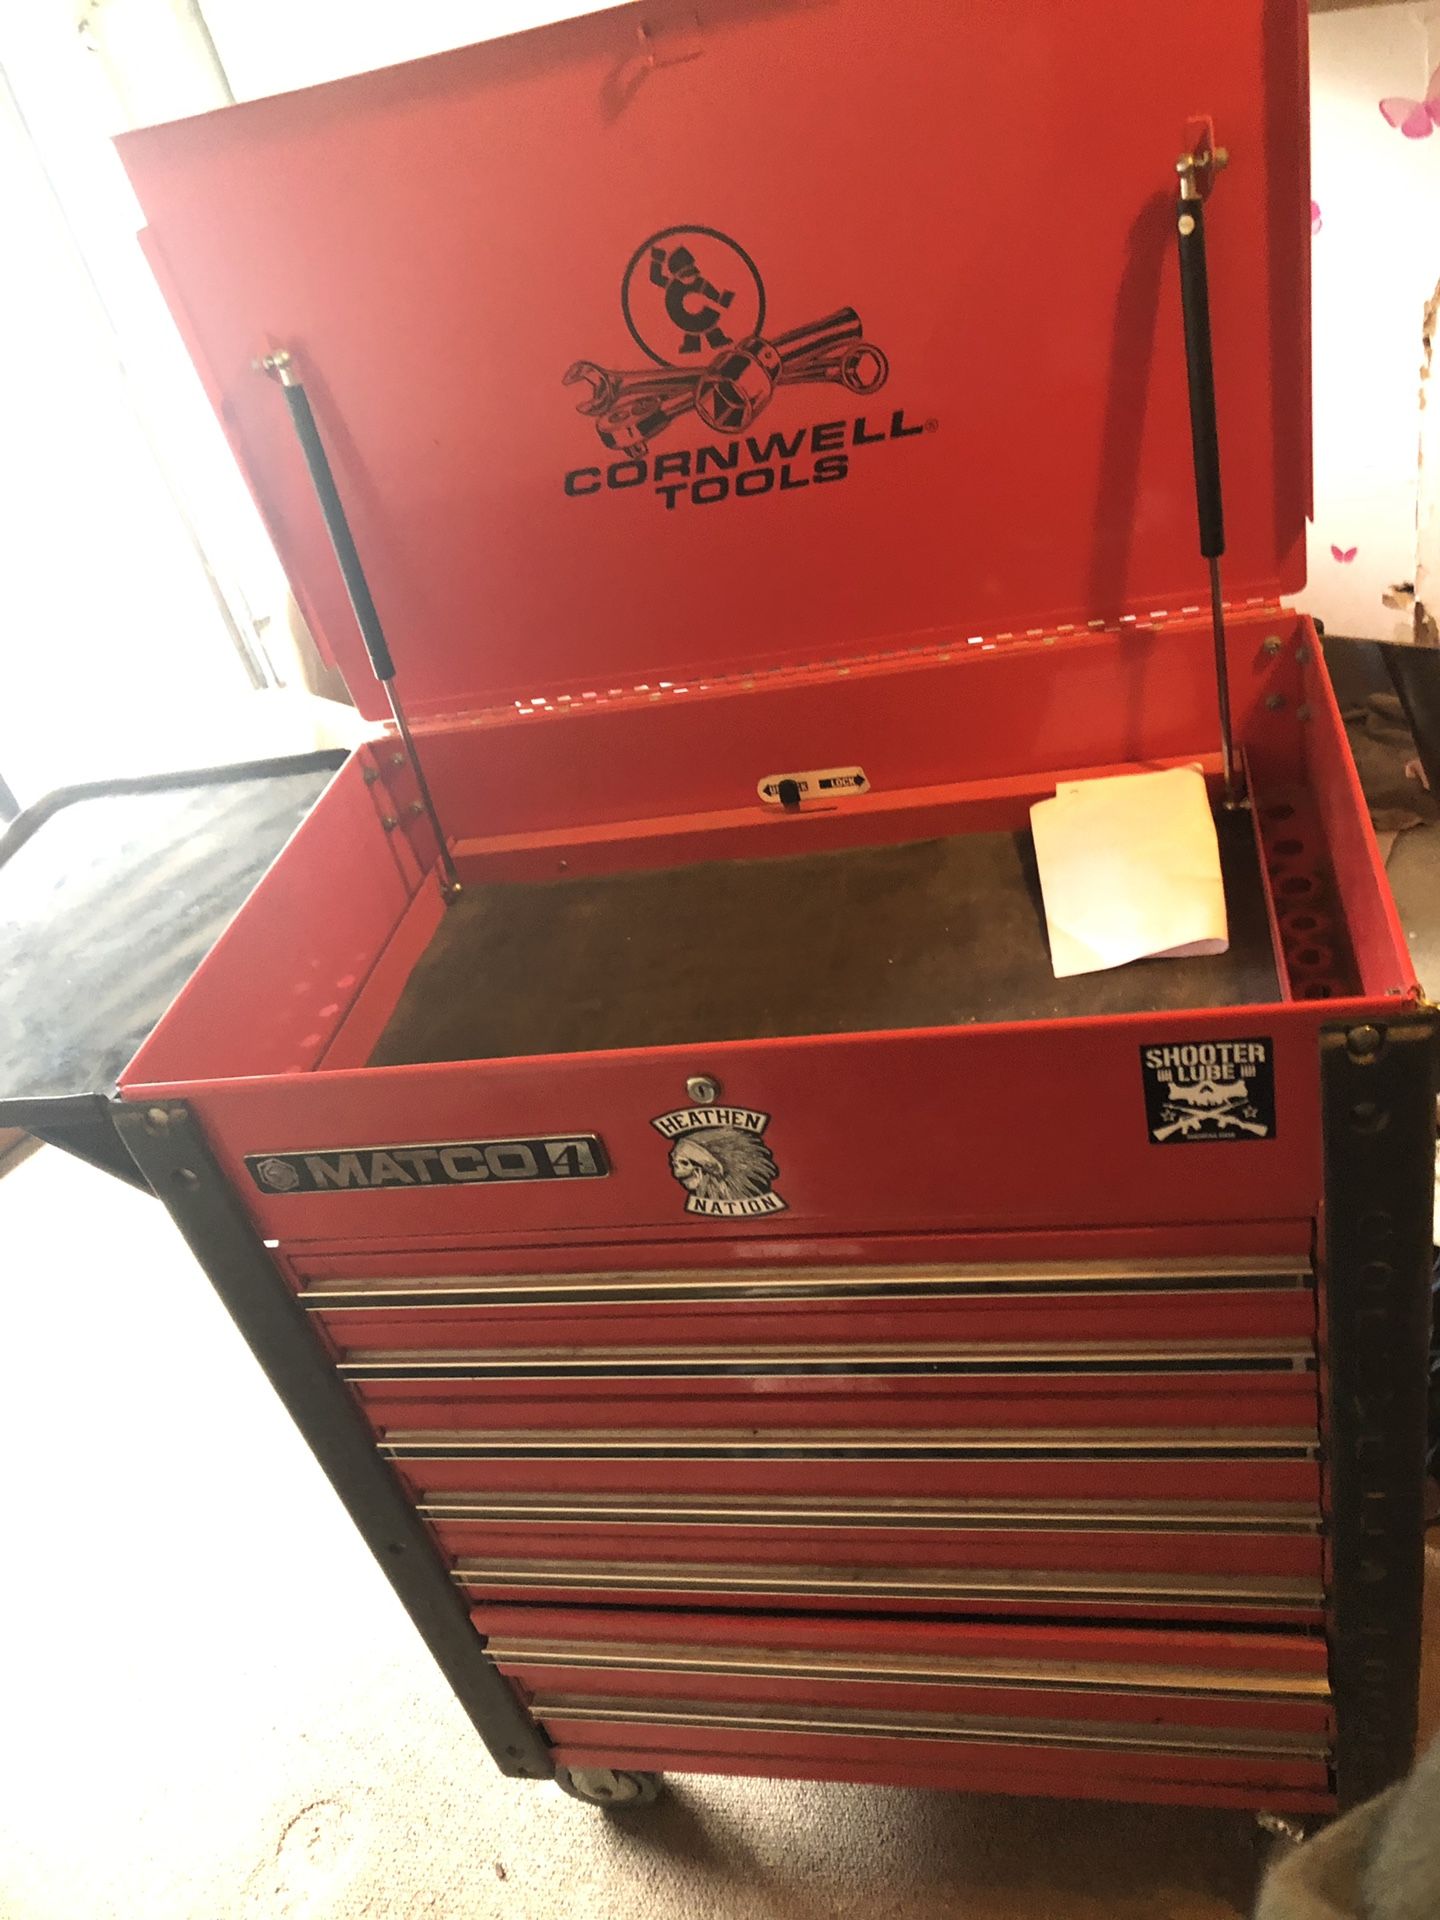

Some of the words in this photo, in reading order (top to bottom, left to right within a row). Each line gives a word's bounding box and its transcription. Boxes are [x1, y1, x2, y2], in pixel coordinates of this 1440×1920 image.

[655, 454, 849, 511] TOOLS
[831, 776, 855, 788] LOCK
[1146, 1043, 1266, 1069] SHOOTER
[1178, 1063, 1235, 1082] LUBE
[659, 1109, 761, 1134] HEATHEN
[304, 1143, 540, 1188] MATCO
[694, 1196, 777, 1215] NATION
